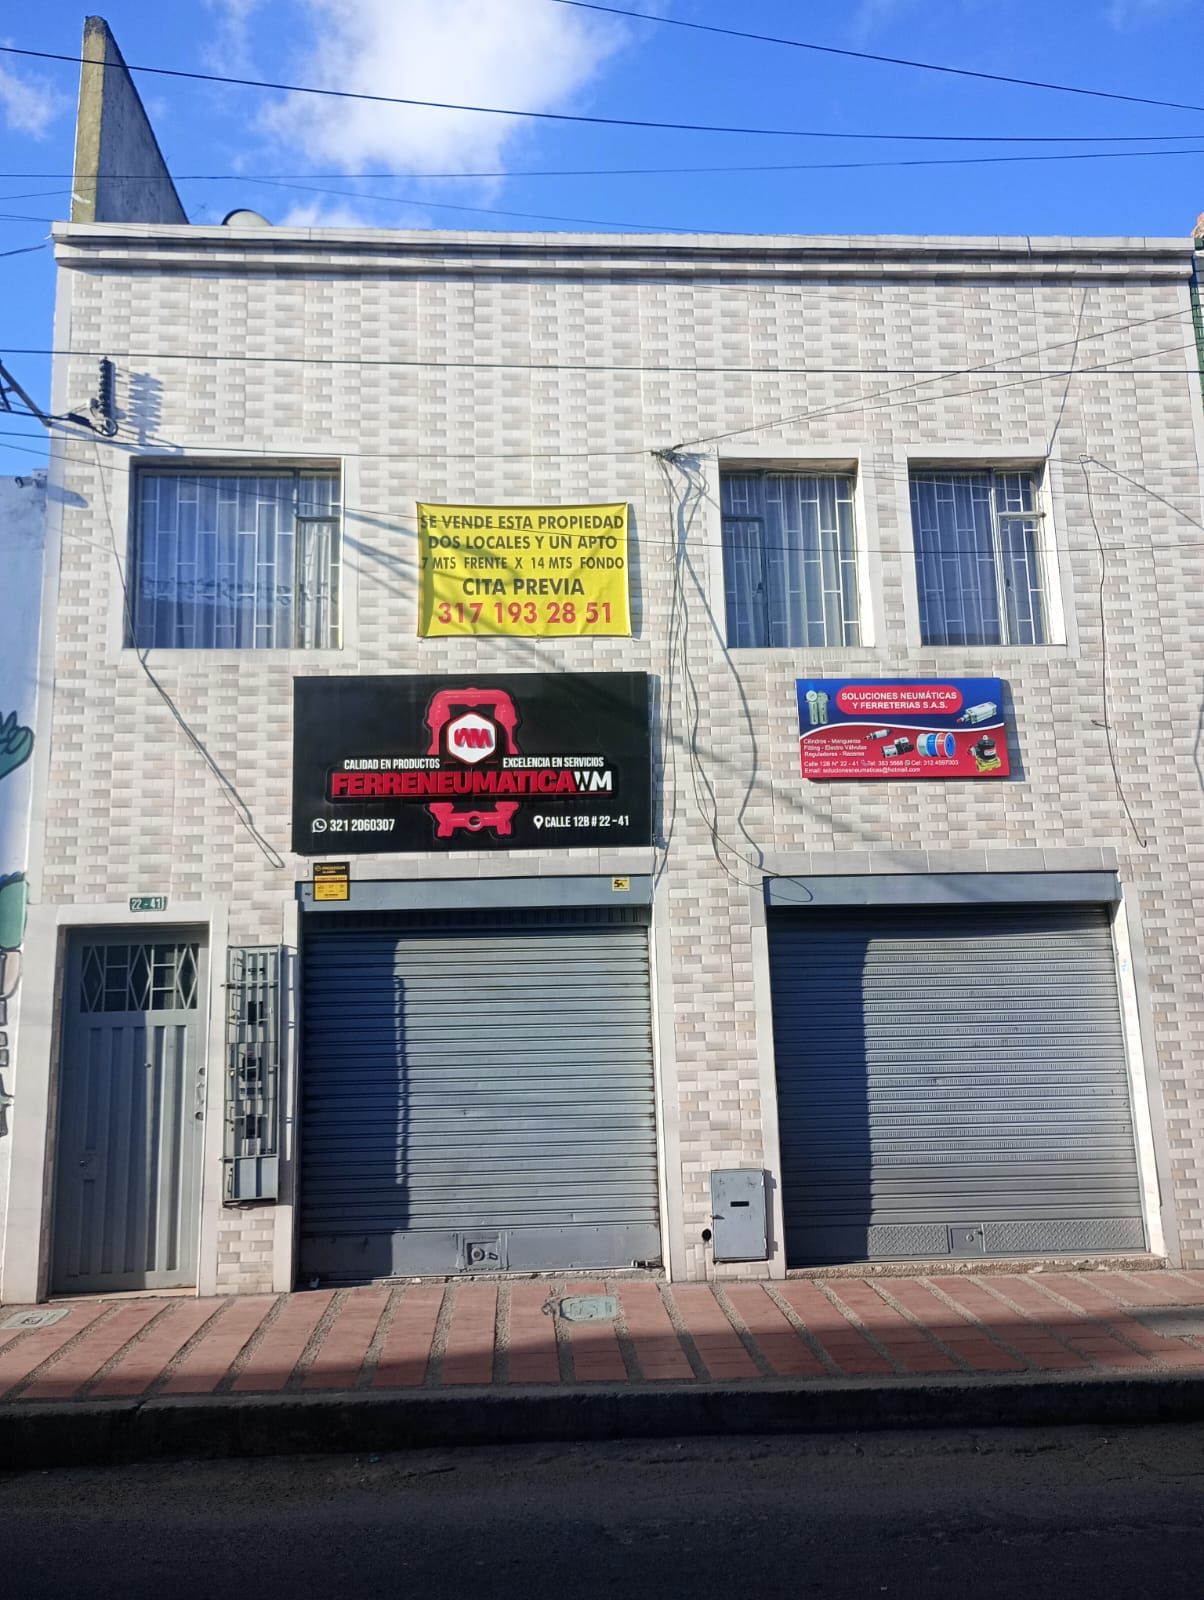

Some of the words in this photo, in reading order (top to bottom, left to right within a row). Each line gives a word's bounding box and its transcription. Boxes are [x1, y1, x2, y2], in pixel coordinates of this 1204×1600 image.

[421, 515, 437, 529] SE
[442, 515, 493, 529] VENDE
[499, 515, 533, 529] ESTA
[538, 515, 624, 529] PROPIEDAD
[428, 535, 460, 549] DOS
[466, 535, 531, 550] LOCALES
[534, 535, 544, 549] Y
[549, 535, 572, 549] UN
[577, 535, 618, 549] APTO
[422, 557, 429, 569] 7
[432, 557, 457, 569] MTS
[464, 557, 508, 569] FRENTE
[515, 557, 523, 569] X
[530, 557, 545, 569] 14
[549, 557, 573, 569] MTS
[580, 557, 624, 569] FONDO
[462, 578, 507, 596] CITA
[513, 578, 585, 595] PREVIA
[438, 602, 483, 624] 317
[494, 602, 538, 624] 193
[547, 602, 576, 624] 28
[585, 602, 611, 624] 51
[841, 692, 898, 700] SOLUCIONES
[900, 690, 957, 700] NEUMÁTICAS
[923, 701, 948, 709] S.A.S.
[344, 758, 378, 770] CALIDAD
[380, 758, 391, 769] EN
[393, 758, 440, 769] PRODUCTOS
[502, 757, 550, 768] EXCELENCIA
[552, 757, 563, 768] EN
[563, 756, 605, 768] SERVICIOS
[329, 819, 348, 832] 321
[351, 818, 395, 831] 2060307
[545, 815, 571, 828] CALLE
[573, 815, 589, 827] 12B
[591, 816, 597, 827] #
